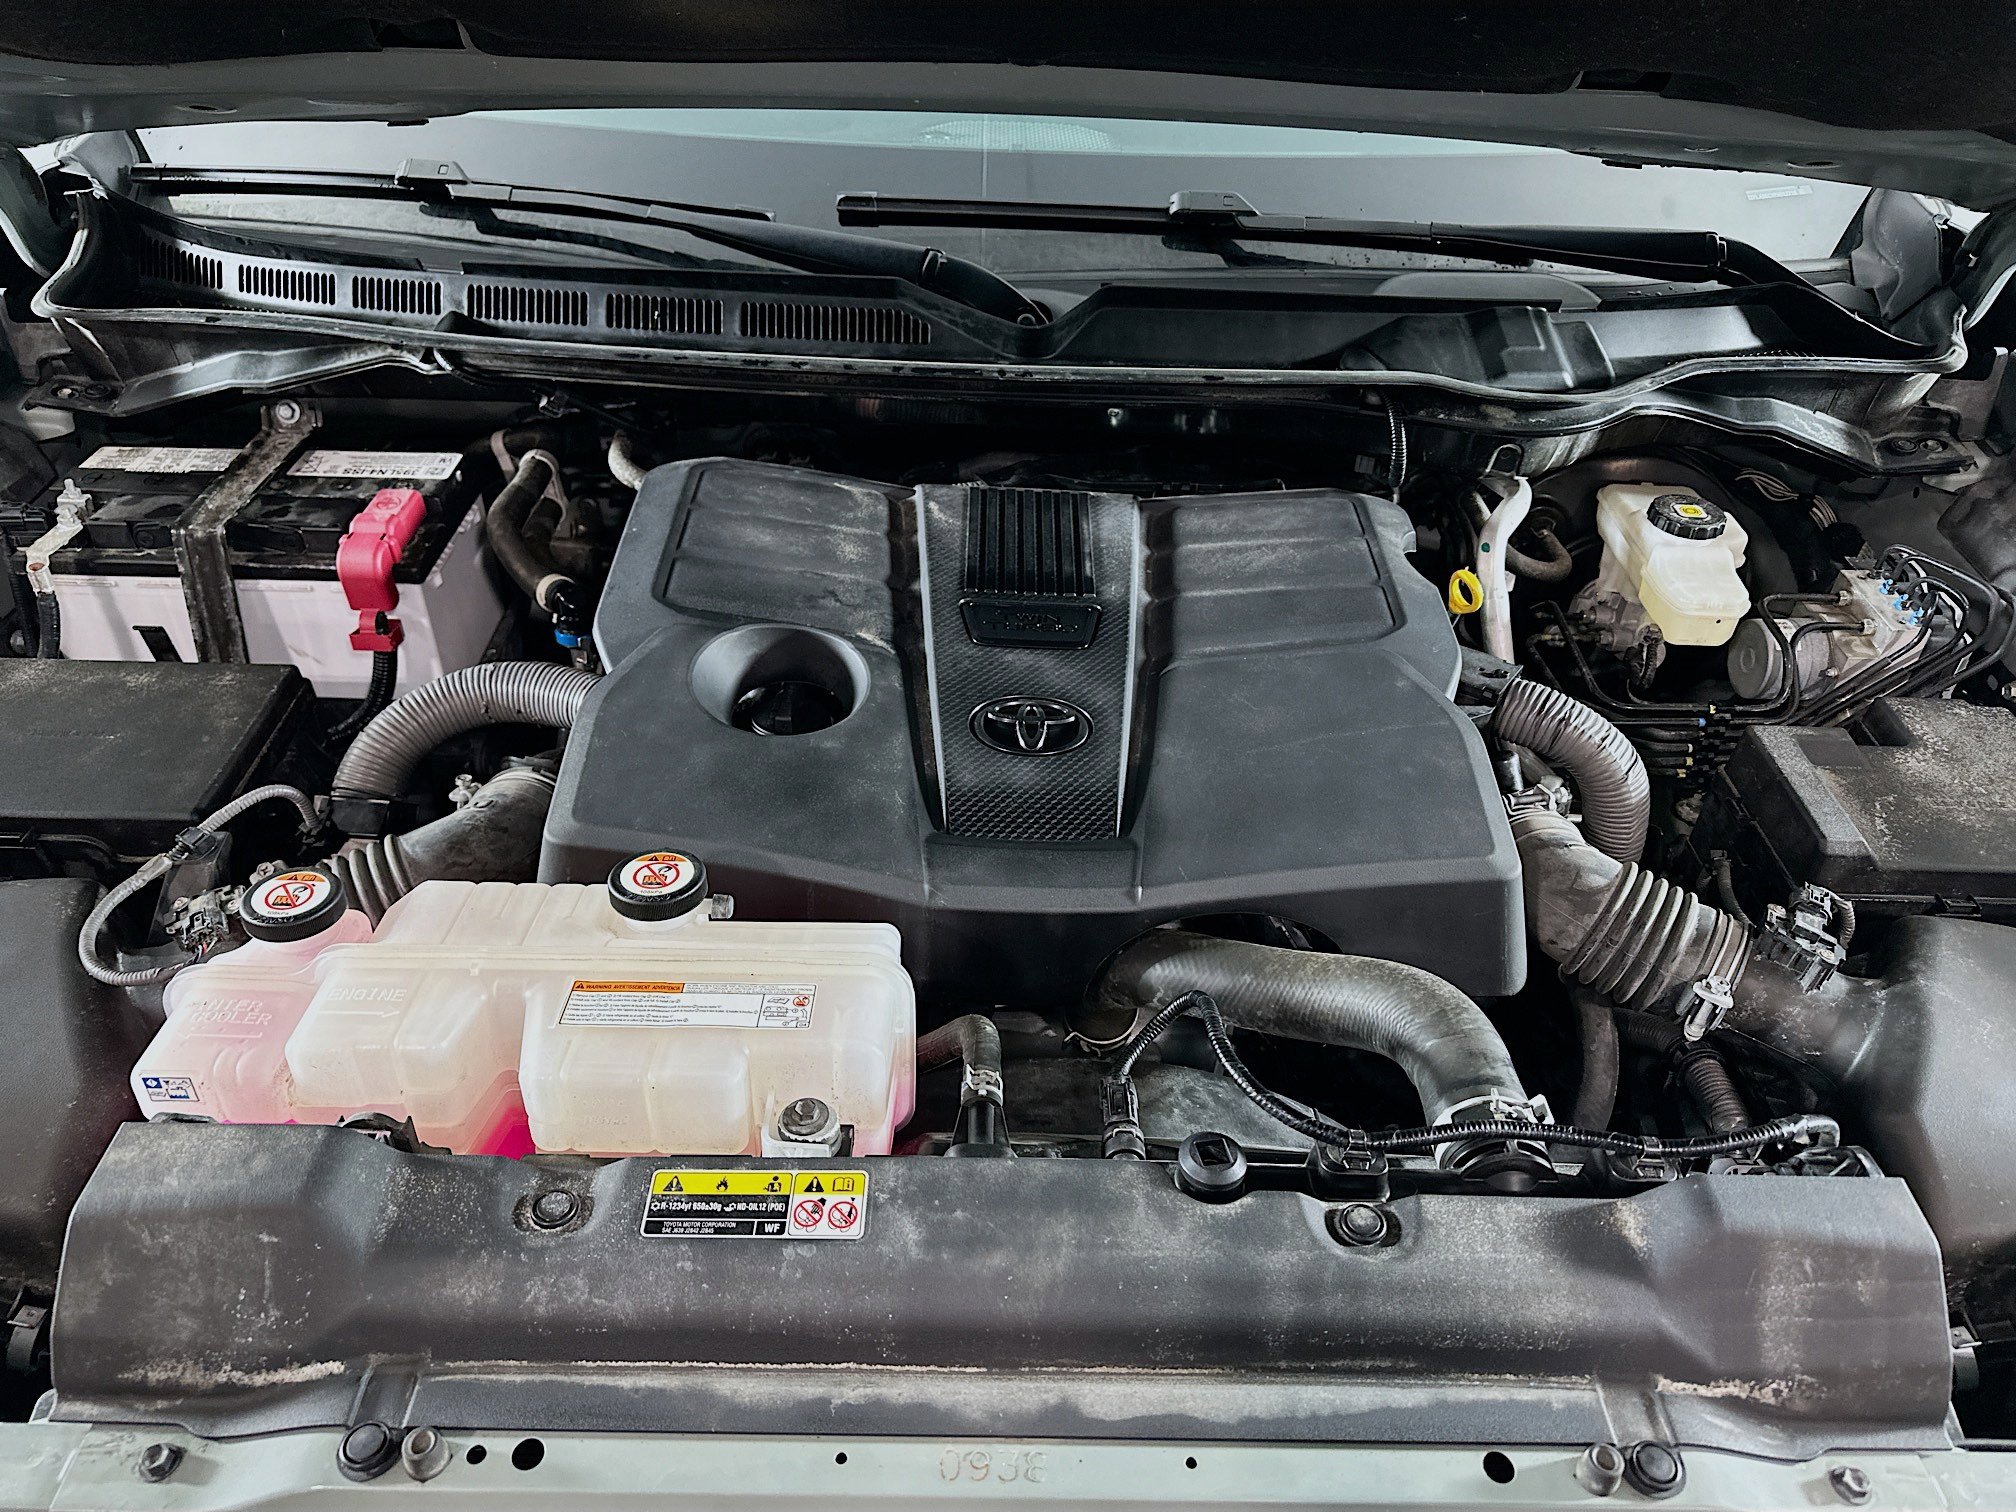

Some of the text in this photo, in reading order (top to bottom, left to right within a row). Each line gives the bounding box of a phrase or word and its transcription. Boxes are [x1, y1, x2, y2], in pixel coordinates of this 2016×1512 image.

[328, 988, 408, 1002] ENGINE
[191, 1011, 273, 1026] COOLER
[660, 1201, 692, 1212] R-1234yf
[767, 1202, 786, 1213] (POE)
[764, 1223, 781, 1233] WF
